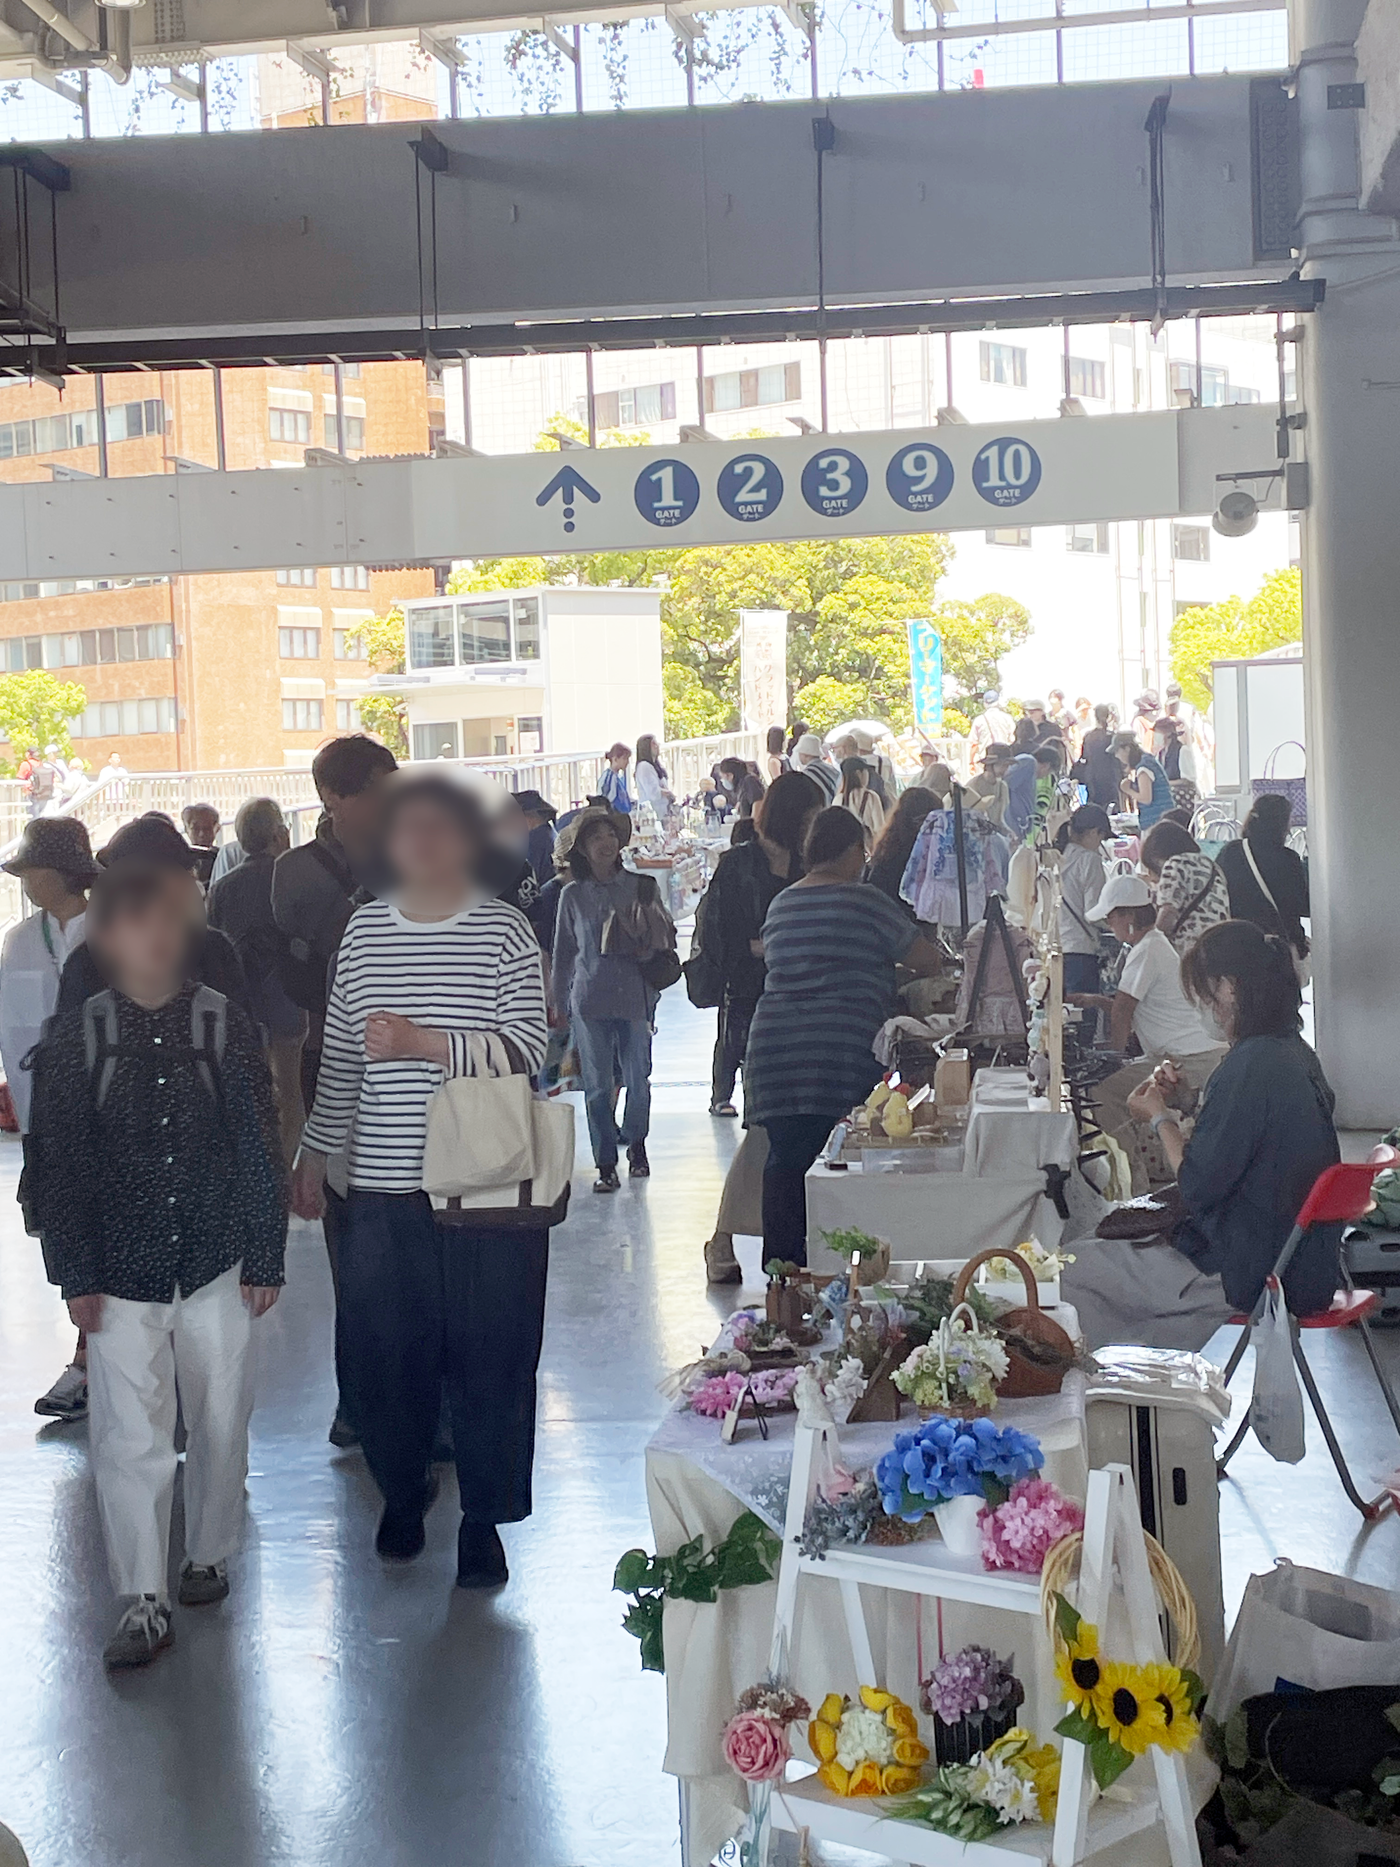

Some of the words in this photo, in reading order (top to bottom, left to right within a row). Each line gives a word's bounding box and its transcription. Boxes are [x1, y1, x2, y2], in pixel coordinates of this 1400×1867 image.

[818, 455, 851, 497] 3
[902, 450, 938, 492] 9
[981, 444, 1031, 487] 10
[649, 465, 683, 508] 1
[733, 460, 767, 503] 2
[994, 489, 1021, 498] GATE
[738, 504, 764, 513] GATE
[822, 499, 848, 509] GATE
[908, 494, 934, 503] GATE
[655, 509, 681, 519] GATE
